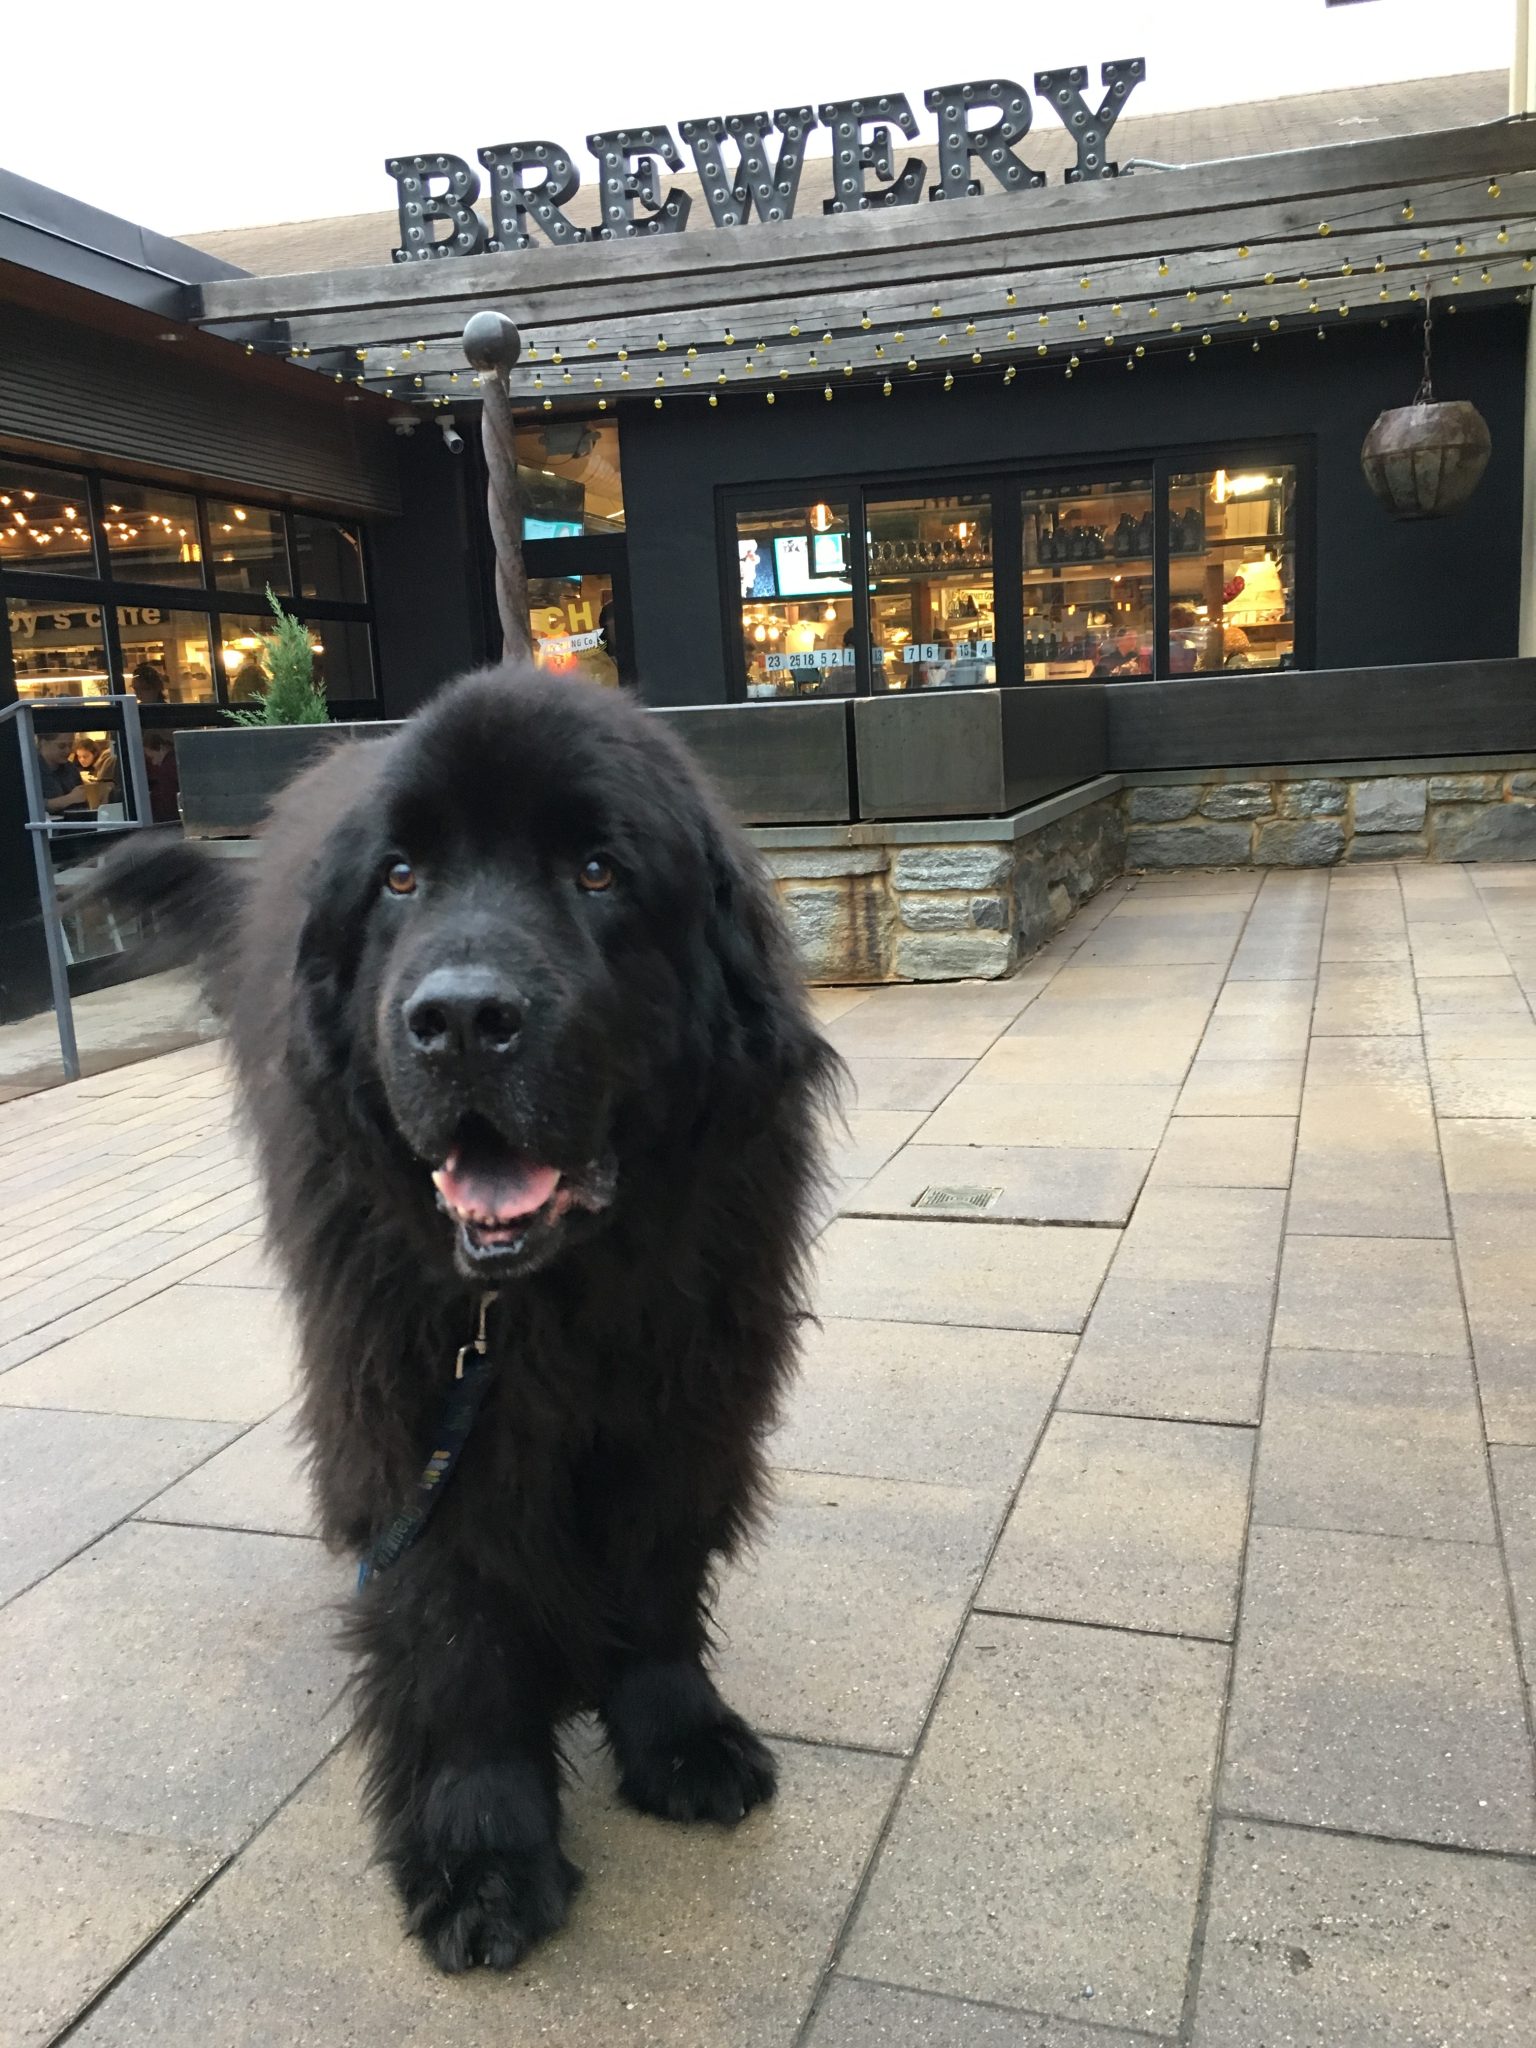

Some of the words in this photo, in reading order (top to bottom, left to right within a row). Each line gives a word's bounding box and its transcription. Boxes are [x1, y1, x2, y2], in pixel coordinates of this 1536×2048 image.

[384, 57, 1146, 262] BREWERY
[768, 655, 781, 668] 23
[789, 654, 801, 667] 25
[803, 653, 815, 666] 18
[820, 652, 828, 665] 5
[831, 652, 838, 664] 2
[908, 647, 915, 660] 7
[926, 646, 933, 659] 6
[960, 644, 969, 657] 15
[981, 643, 988, 656] 4
